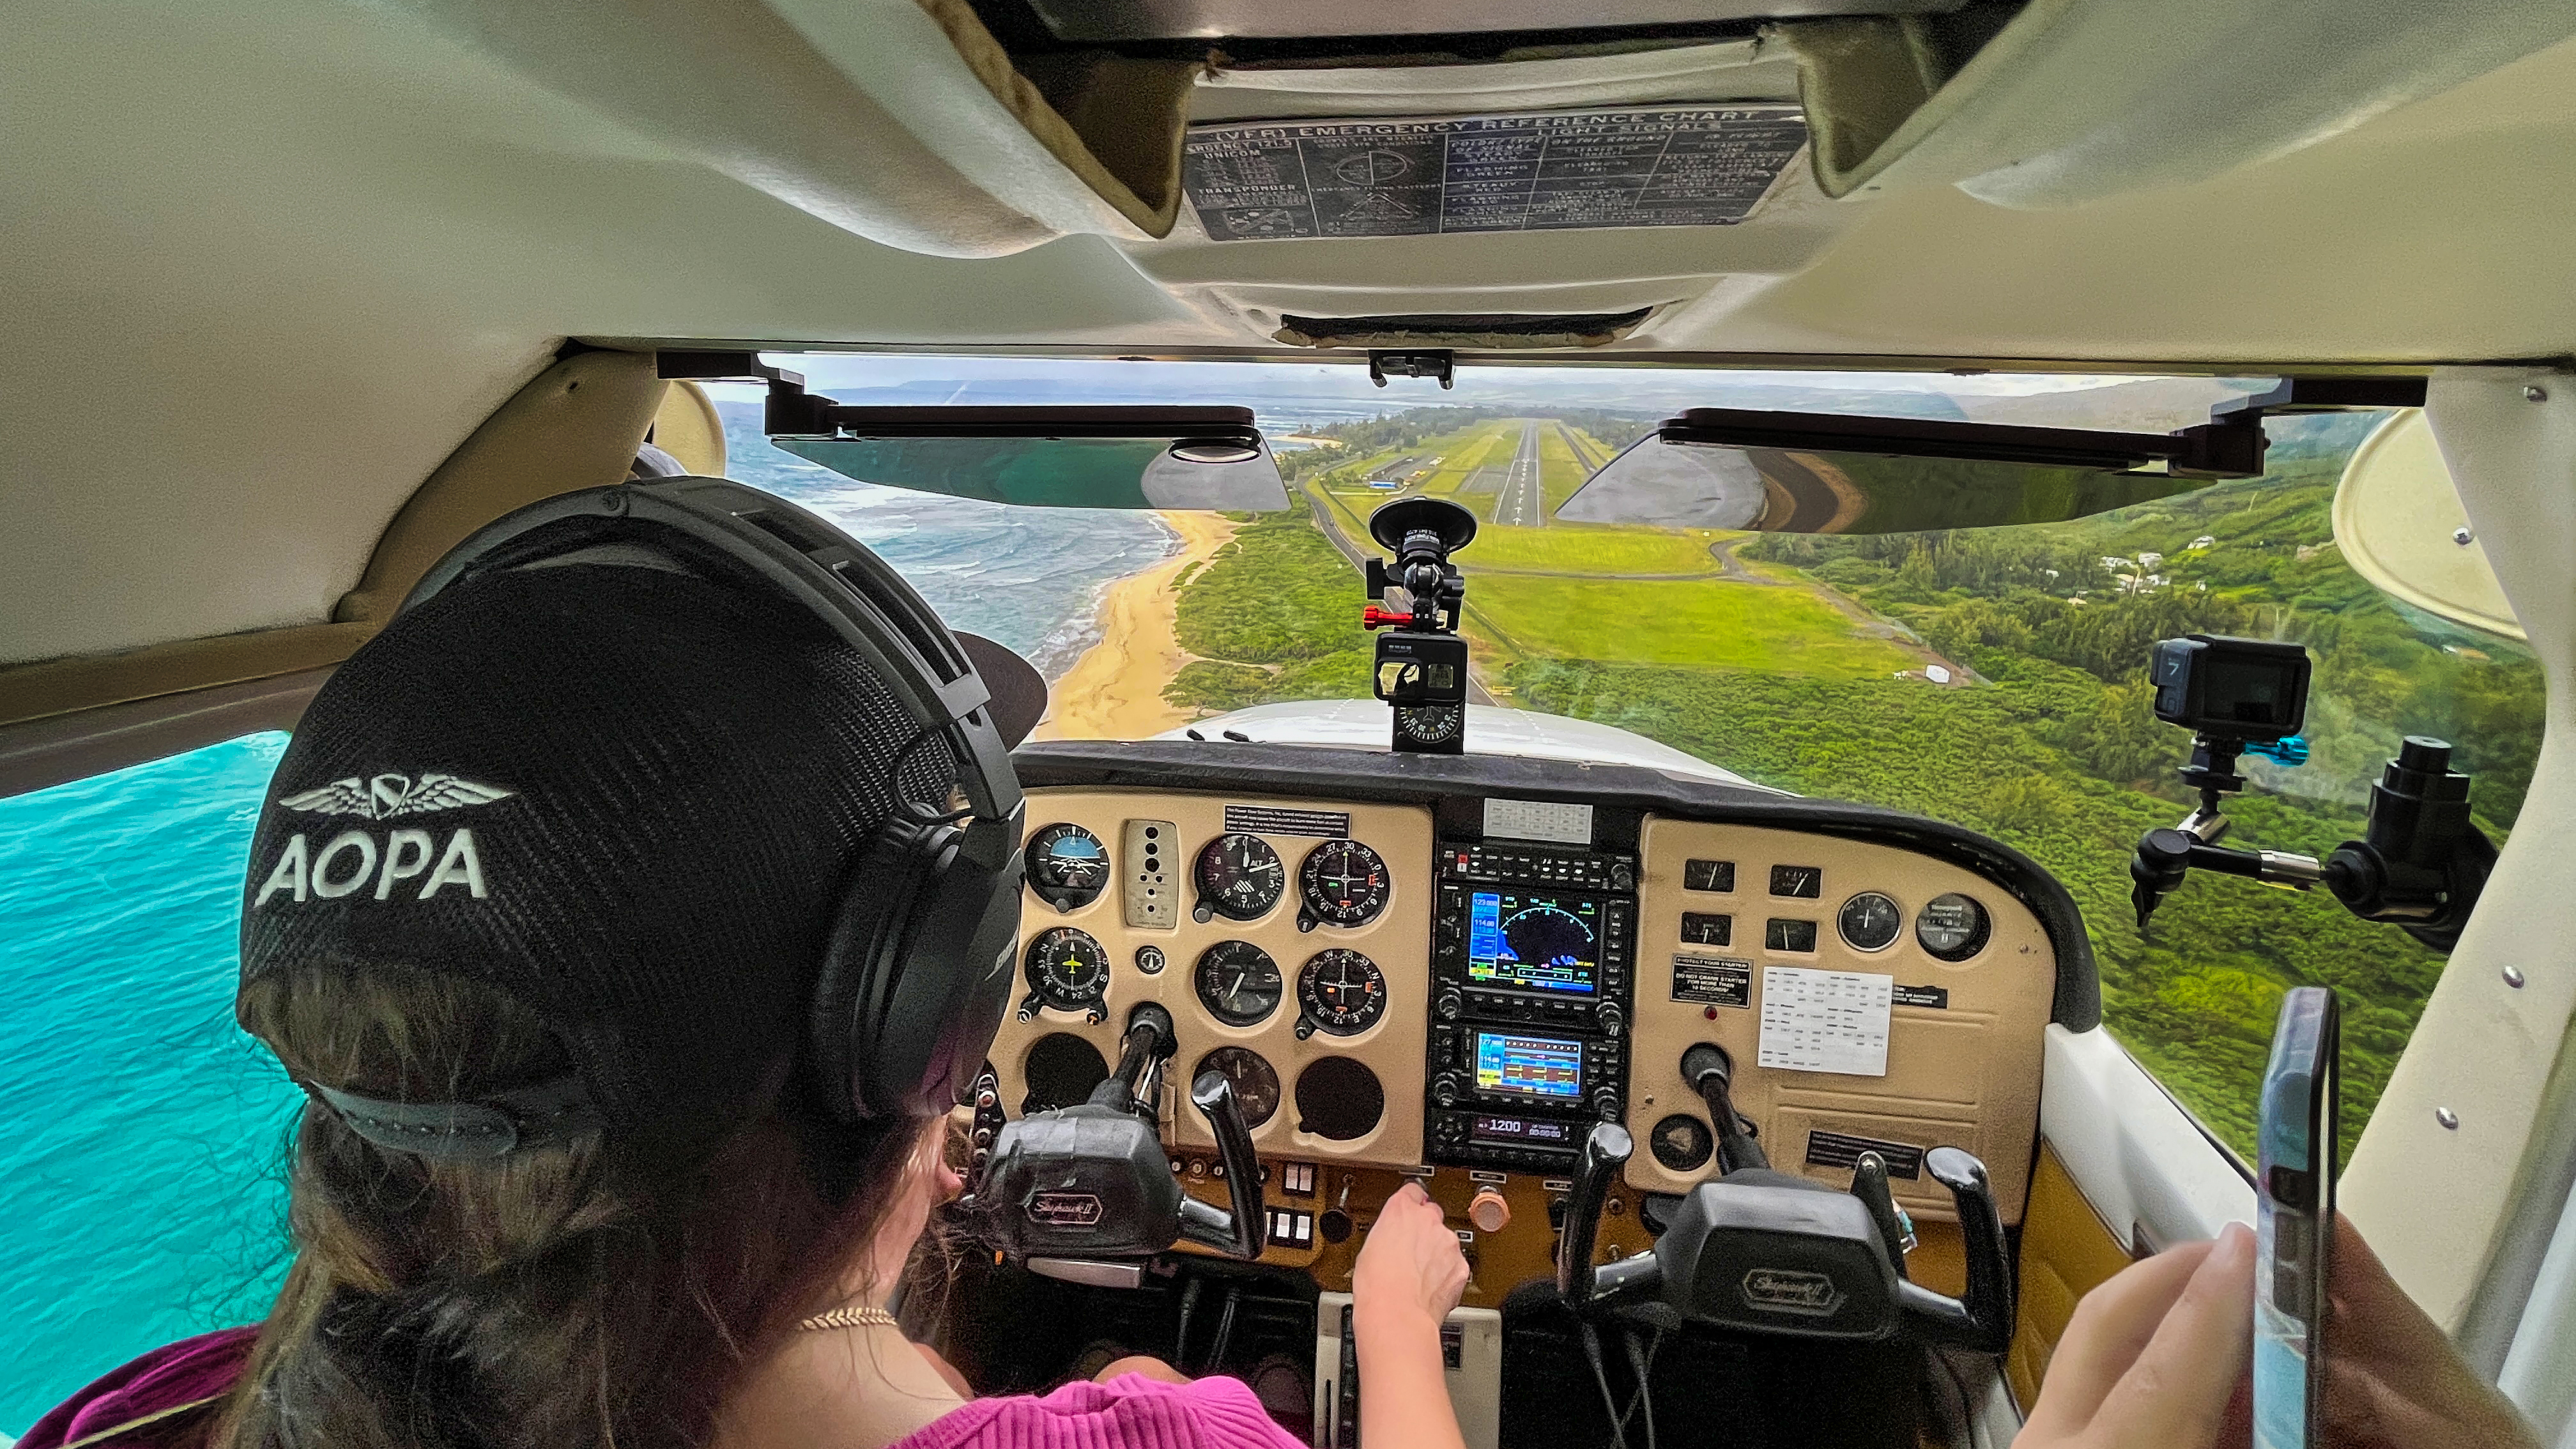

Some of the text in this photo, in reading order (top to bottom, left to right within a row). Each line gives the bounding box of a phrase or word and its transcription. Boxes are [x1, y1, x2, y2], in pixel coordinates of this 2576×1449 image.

[1299, 123, 1468, 136] EMERGENCY
[1482, 114, 1646, 129] REFERENCE
[1659, 112, 1754, 121] CHART
[1204, 150, 1261, 159] UNICOM
[2168, 662, 2179, 676] 7
[1326, 843, 1335, 852] 27
[1361, 848, 1372, 857] 33
[1215, 856, 1222, 864] 8
[254, 828, 488, 908] AOPA
[1213, 873, 1220, 881] 7
[1307, 870, 1314, 878] 21
[1268, 879, 1275, 888] 3
[1224, 887, 1231, 897] 6
[1241, 894, 1248, 903] 5
[1337, 910, 1347, 918] 12
[1040, 944, 1048, 953] N
[1360, 957, 1370, 966] 33
[1100, 974, 1108, 983] S
[1055, 988, 1064, 997] W
[1333, 1016, 1343, 1024] 12
[1489, 1119, 1521, 1133] 1200
